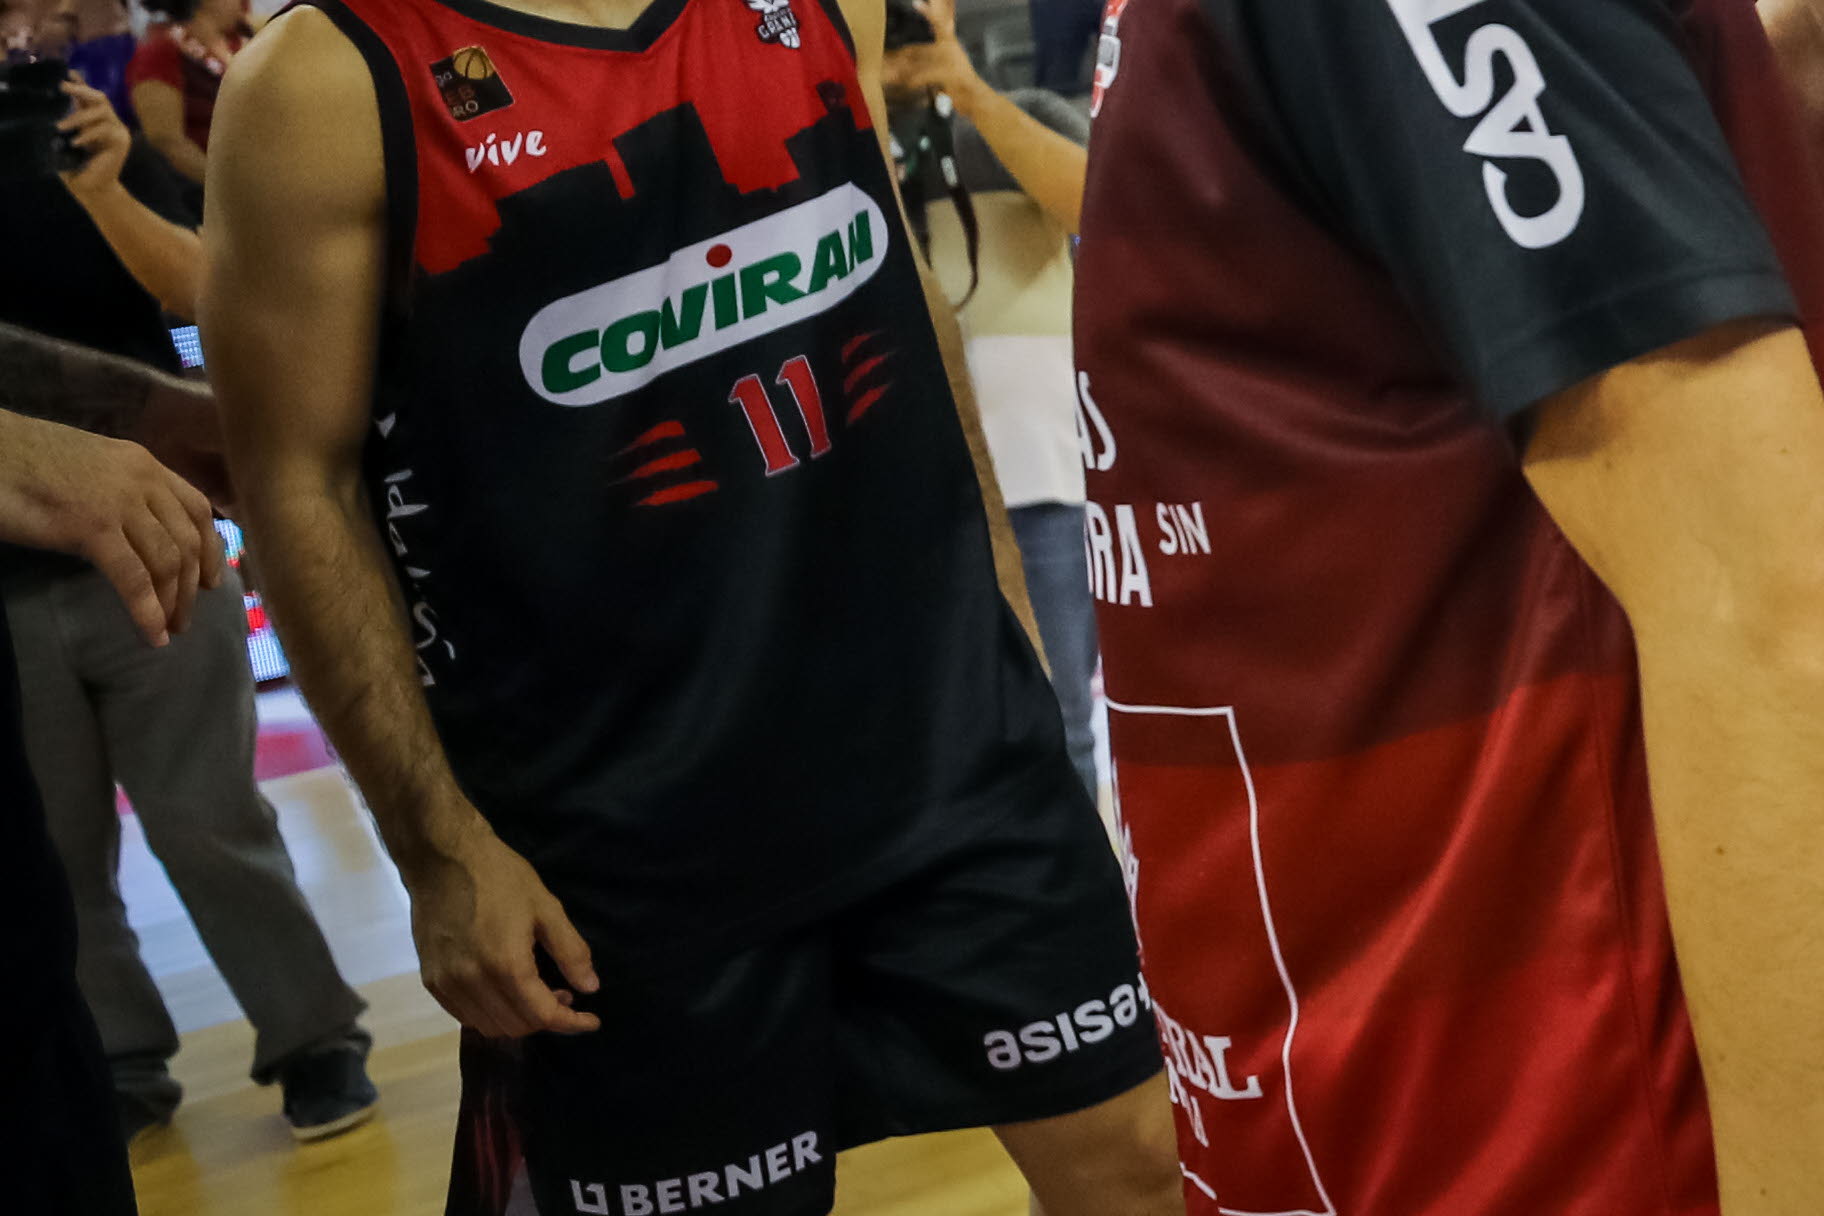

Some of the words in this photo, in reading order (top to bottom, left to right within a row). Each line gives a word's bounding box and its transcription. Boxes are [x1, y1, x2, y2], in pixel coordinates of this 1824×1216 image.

[465, 130, 547, 173] vive
[541, 209, 874, 394] COVIRAN
[728, 354, 832, 477] 11
[1075, 370, 1117, 471] AS
[1084, 500, 1153, 607] RA
[1156, 502, 1212, 555] SIN
[620, 1130, 822, 1216] BERNER
